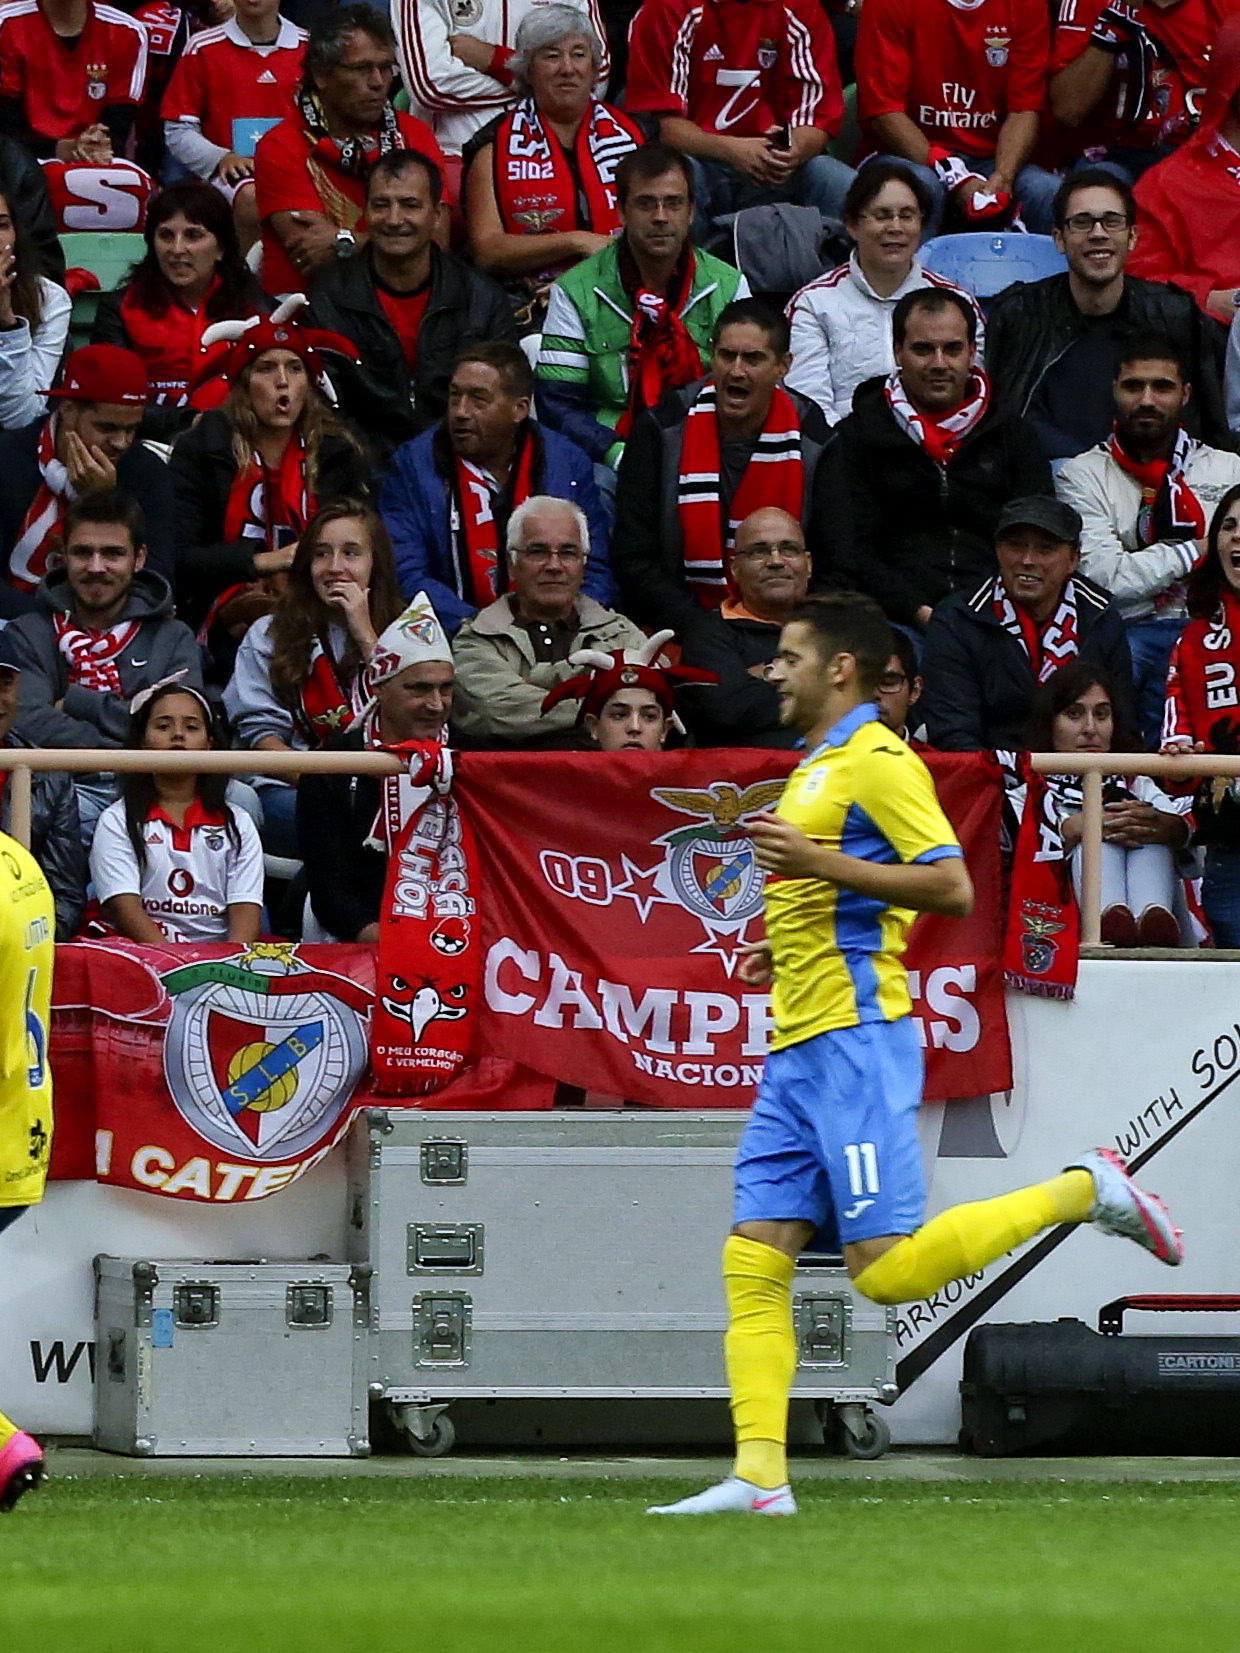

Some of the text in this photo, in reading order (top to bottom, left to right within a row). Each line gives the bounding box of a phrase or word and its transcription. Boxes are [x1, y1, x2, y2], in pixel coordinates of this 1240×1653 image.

[942, 82, 976, 109] Fly
[388, 775, 400, 833] ENFICA
[540, 850, 612, 906] 09
[142, 898, 219, 916] vodafone
[1115, 1023, 1240, 1157] WITH SO
[843, 1142, 880, 1197] 11
[1165, 1356, 1234, 1369] CARTONI
